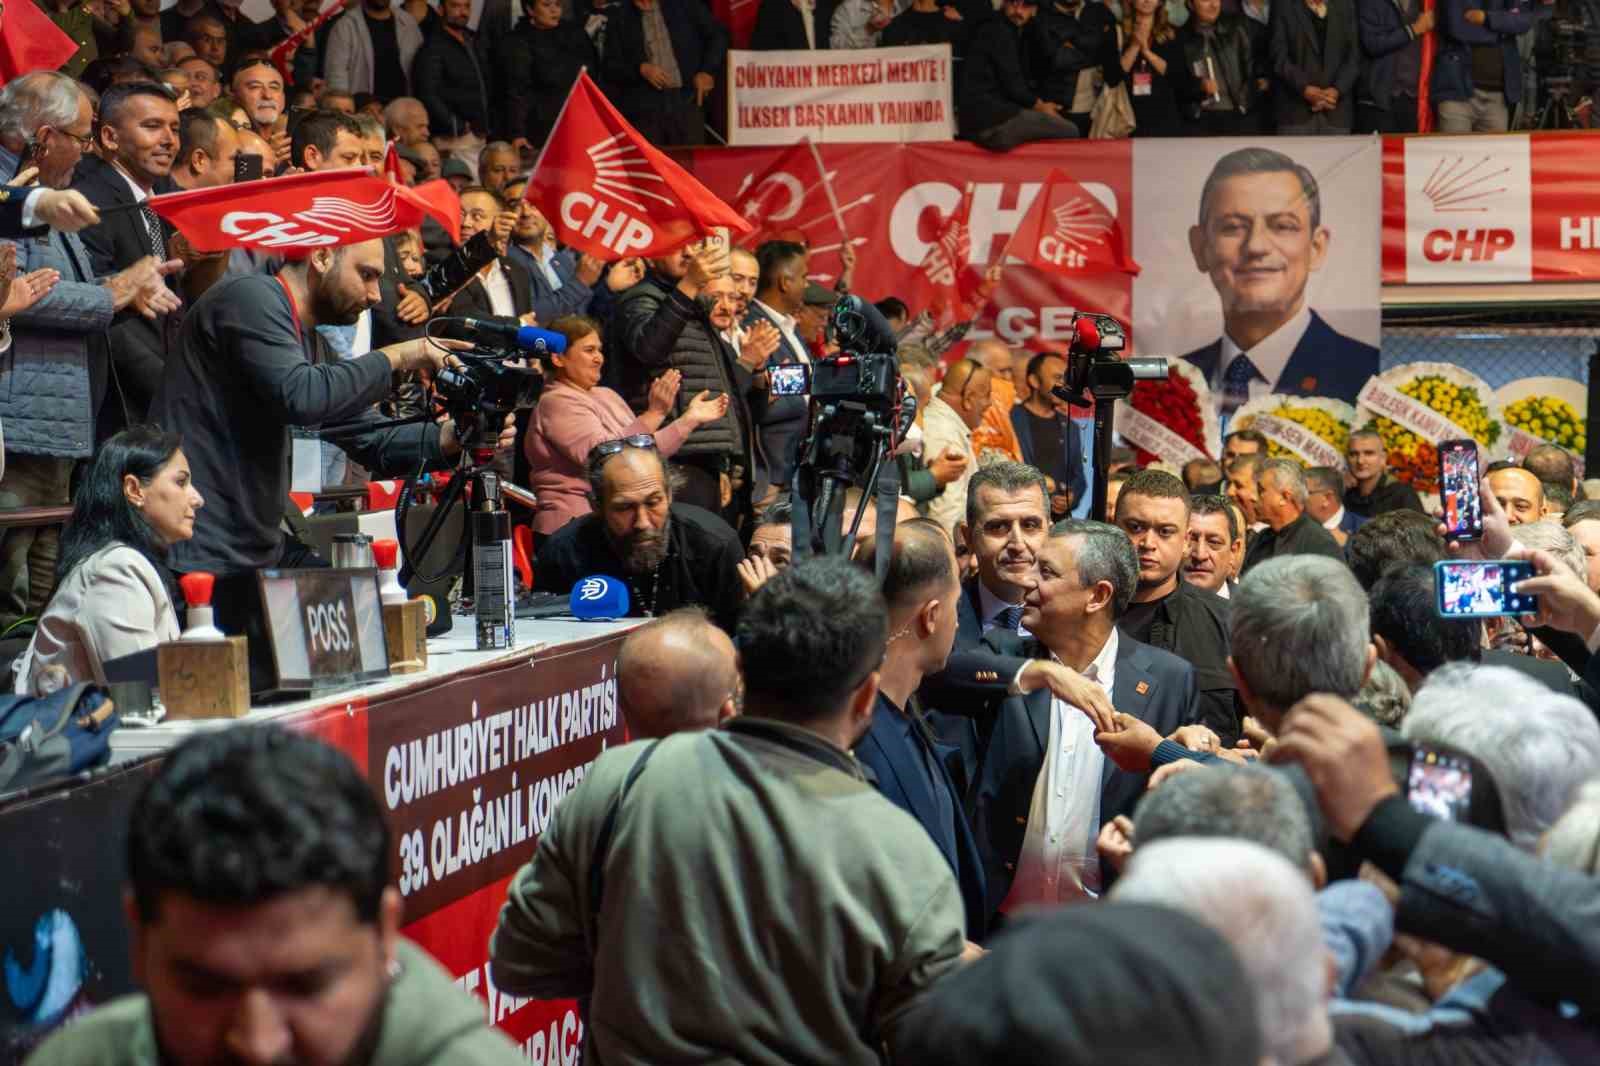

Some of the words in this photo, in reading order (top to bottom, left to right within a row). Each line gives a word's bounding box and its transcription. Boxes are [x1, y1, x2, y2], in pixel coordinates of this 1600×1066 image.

[736, 61, 812, 88] DÜNYANIN
[816, 59, 881, 86] MERKEZİ
[879, 100, 944, 124] YANINDA
[560, 191, 654, 255] CHP
[889, 182, 1119, 267] CH
[1422, 229, 1515, 262] CHP
[384, 700, 512, 810] CUMHURİYET
[514, 695, 560, 762] HALK
[561, 660, 617, 745] PARTİSİ
[399, 828, 429, 897] 39.
[431, 785, 510, 882] OLAĞAN
[511, 771, 526, 846] İL
